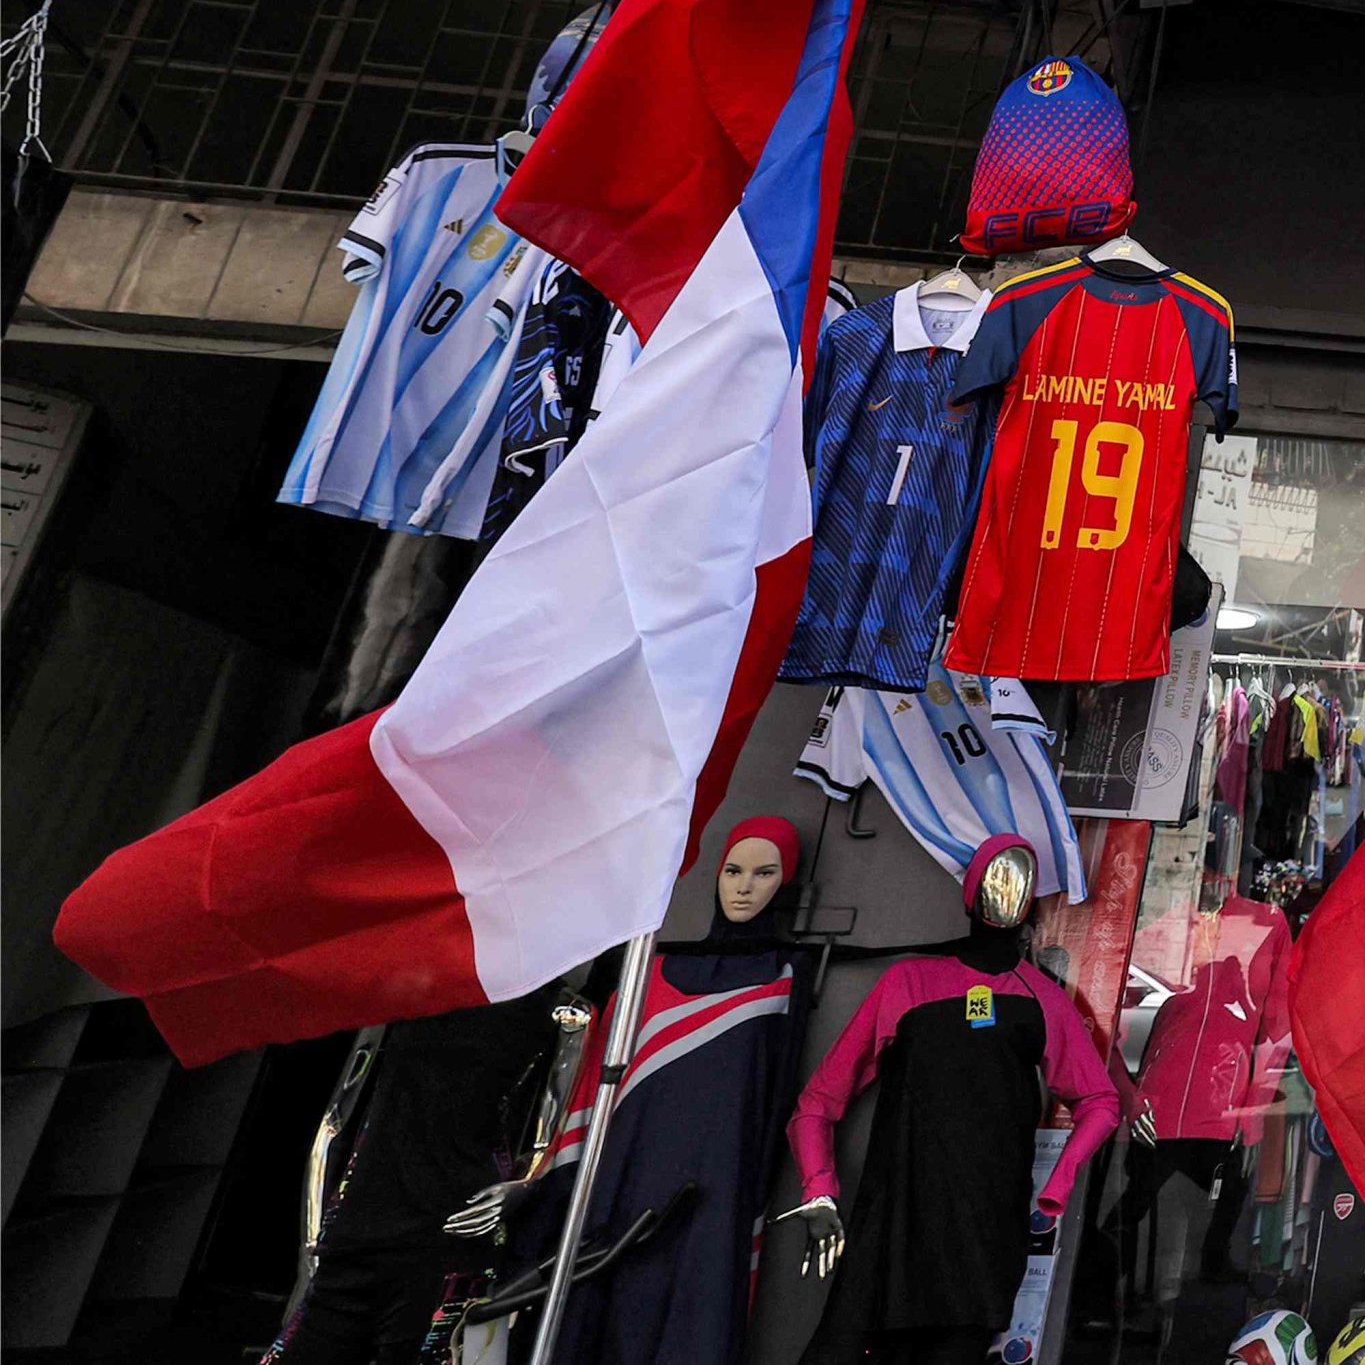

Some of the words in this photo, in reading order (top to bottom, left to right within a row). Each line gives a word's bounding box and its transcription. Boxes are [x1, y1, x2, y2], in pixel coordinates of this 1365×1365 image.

[413, 281, 464, 336] 10
[1022, 374, 1107, 406] LAMINE
[886, 444, 914, 506] 1
[1040, 419, 1146, 552] 19
[1172, 648, 1184, 679] LATEX
[1186, 649, 1202, 686] MEMORY
[1162, 679, 1180, 710] PILLOW
[1179, 685, 1195, 720] PILLOW
[940, 722, 987, 767] 10
[1147, 746, 1163, 773] ASS
